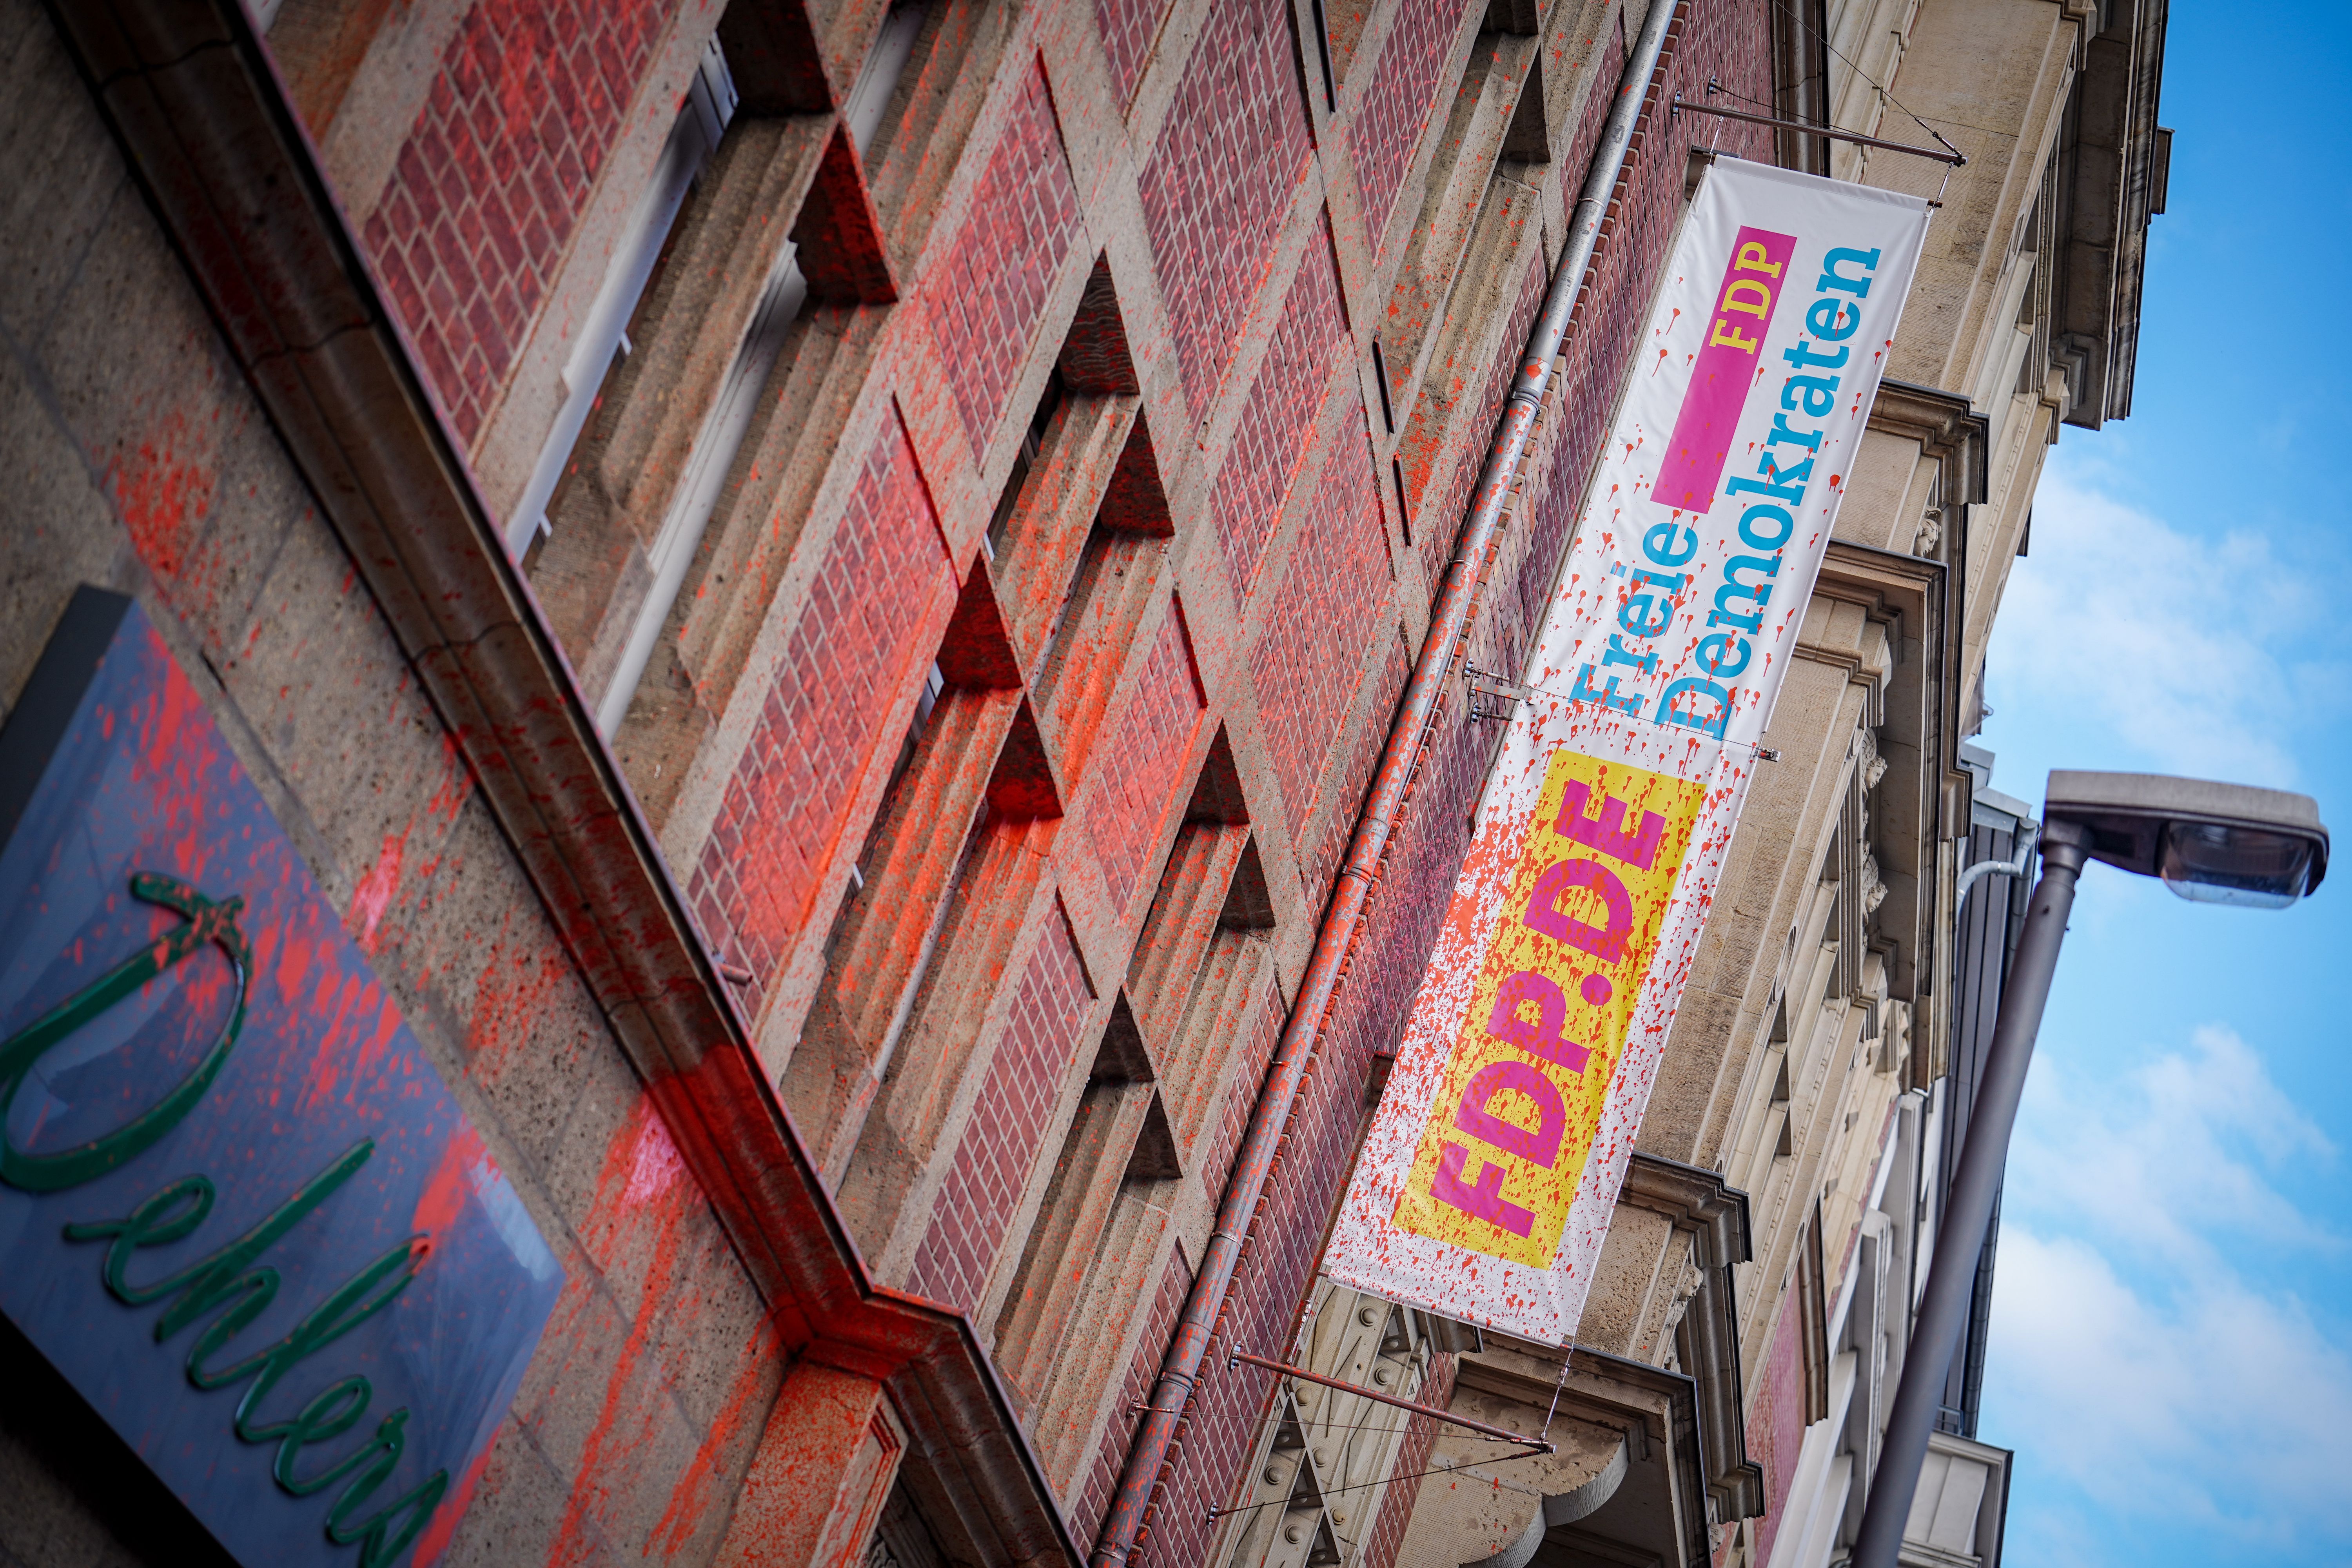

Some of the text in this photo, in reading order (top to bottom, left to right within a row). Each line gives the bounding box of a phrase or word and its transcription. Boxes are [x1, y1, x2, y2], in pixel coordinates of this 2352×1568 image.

[1710, 241, 1782, 355] FDP
[1568, 523, 1698, 719] Freie
[1654, 247, 1881, 740] Demokraten
[1428, 779, 1667, 1239] FDP.DE
